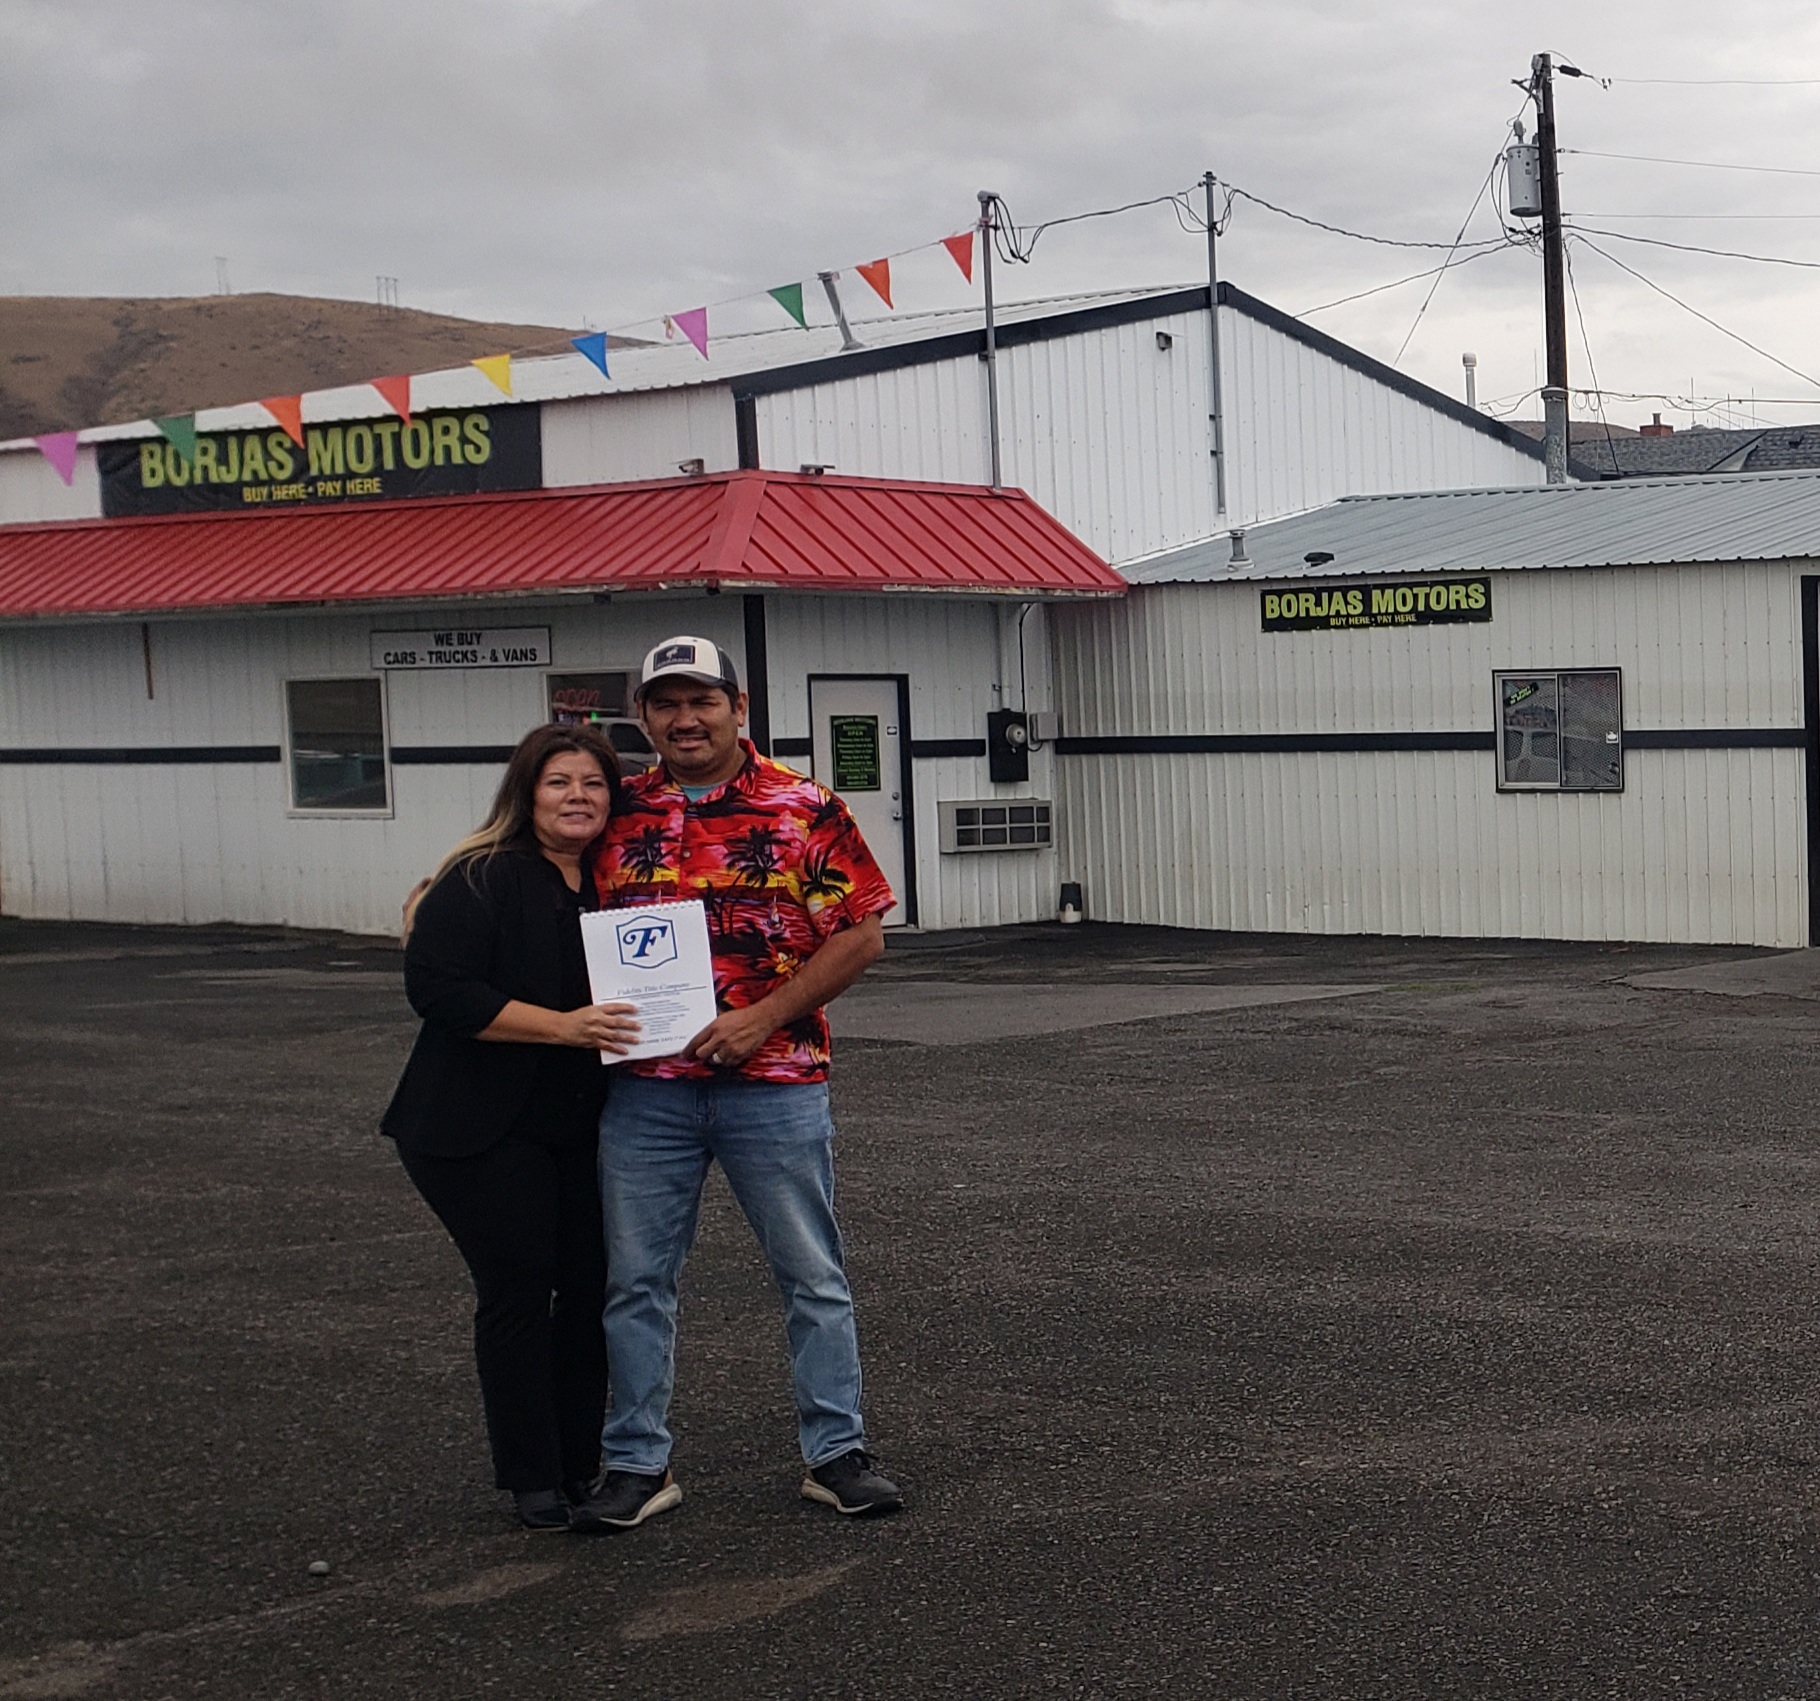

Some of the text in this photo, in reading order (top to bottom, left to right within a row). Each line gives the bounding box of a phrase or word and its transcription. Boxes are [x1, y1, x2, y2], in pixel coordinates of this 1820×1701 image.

[140, 413, 491, 488] BORJAS MOTORS
[243, 486, 268, 502] BUY
[317, 481, 341, 496] PAY
[346, 478, 382, 495] HERE
[1265, 583, 1486, 619] BORJAS MOTORS
[1330, 617, 1347, 626] BUY
[1376, 614, 1392, 623] PAY
[1394, 613, 1417, 622] HERE
[434, 632, 482, 646] WE BUY
[383, 651, 416, 665] CARS
[427, 649, 478, 664] TRUCKS
[489, 650, 499, 662] &
[502, 648, 538, 662] VANS
